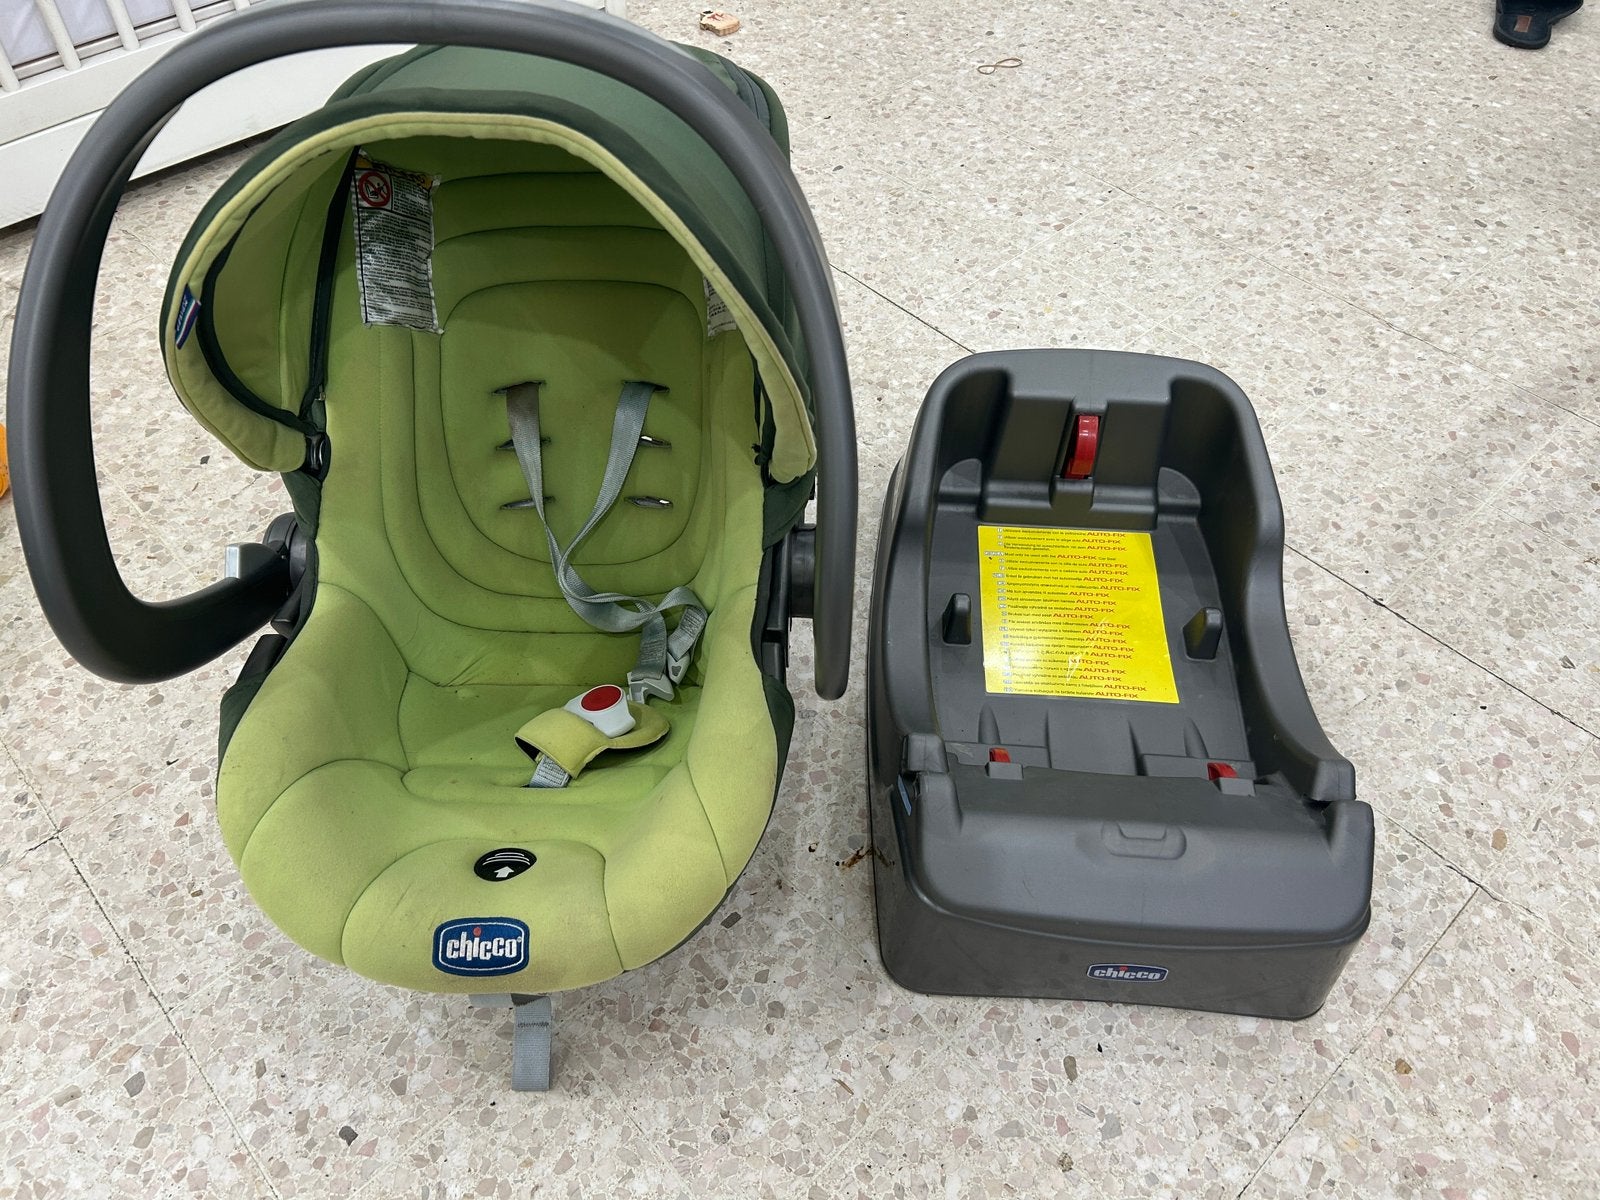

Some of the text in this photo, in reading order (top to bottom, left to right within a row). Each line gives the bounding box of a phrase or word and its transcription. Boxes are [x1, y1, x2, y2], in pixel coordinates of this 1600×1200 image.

[1093, 644, 1135, 652] AUTO-FIX
[1090, 651, 1132, 659] AUTO-FIX
[1095, 691, 1138, 699] AUTO-FIX
[446, 927, 518, 961] chicco
[1093, 966, 1161, 980] chicco
